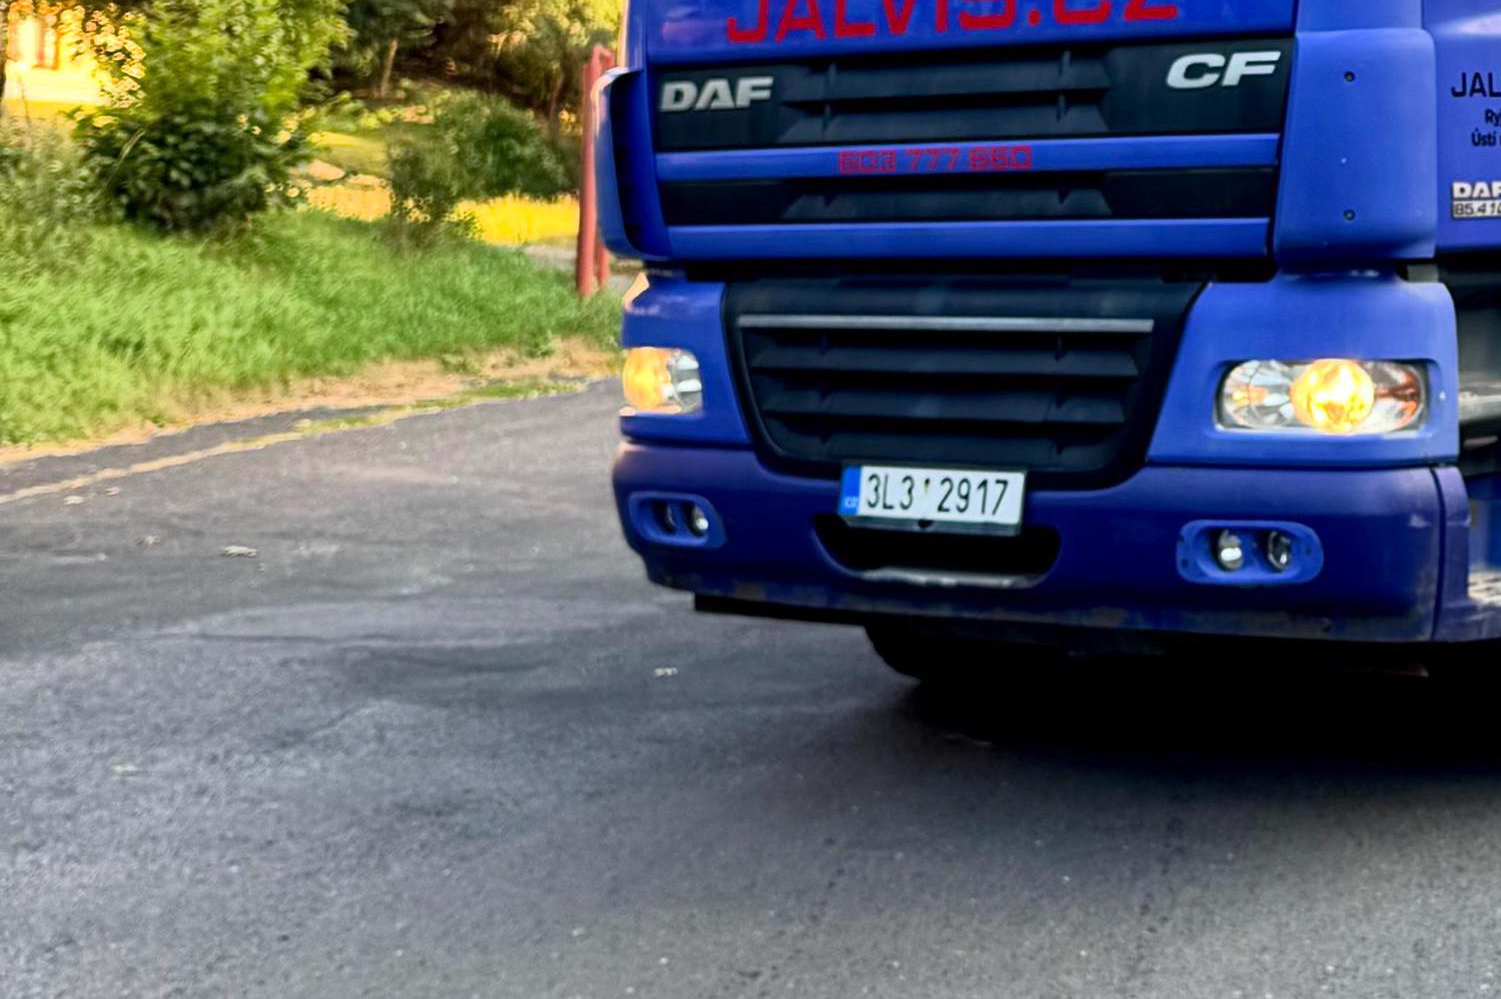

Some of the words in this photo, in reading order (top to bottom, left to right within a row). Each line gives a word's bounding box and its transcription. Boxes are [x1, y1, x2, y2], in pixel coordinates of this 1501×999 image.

[1166, 50, 1281, 89] CF
[660, 76, 774, 113] DAF
[838, 149, 897, 175] 603
[905, 146, 961, 171] 777
[968, 144, 1033, 171] 660
[867, 473, 915, 510] 3L3
[937, 476, 1009, 516] 2917
